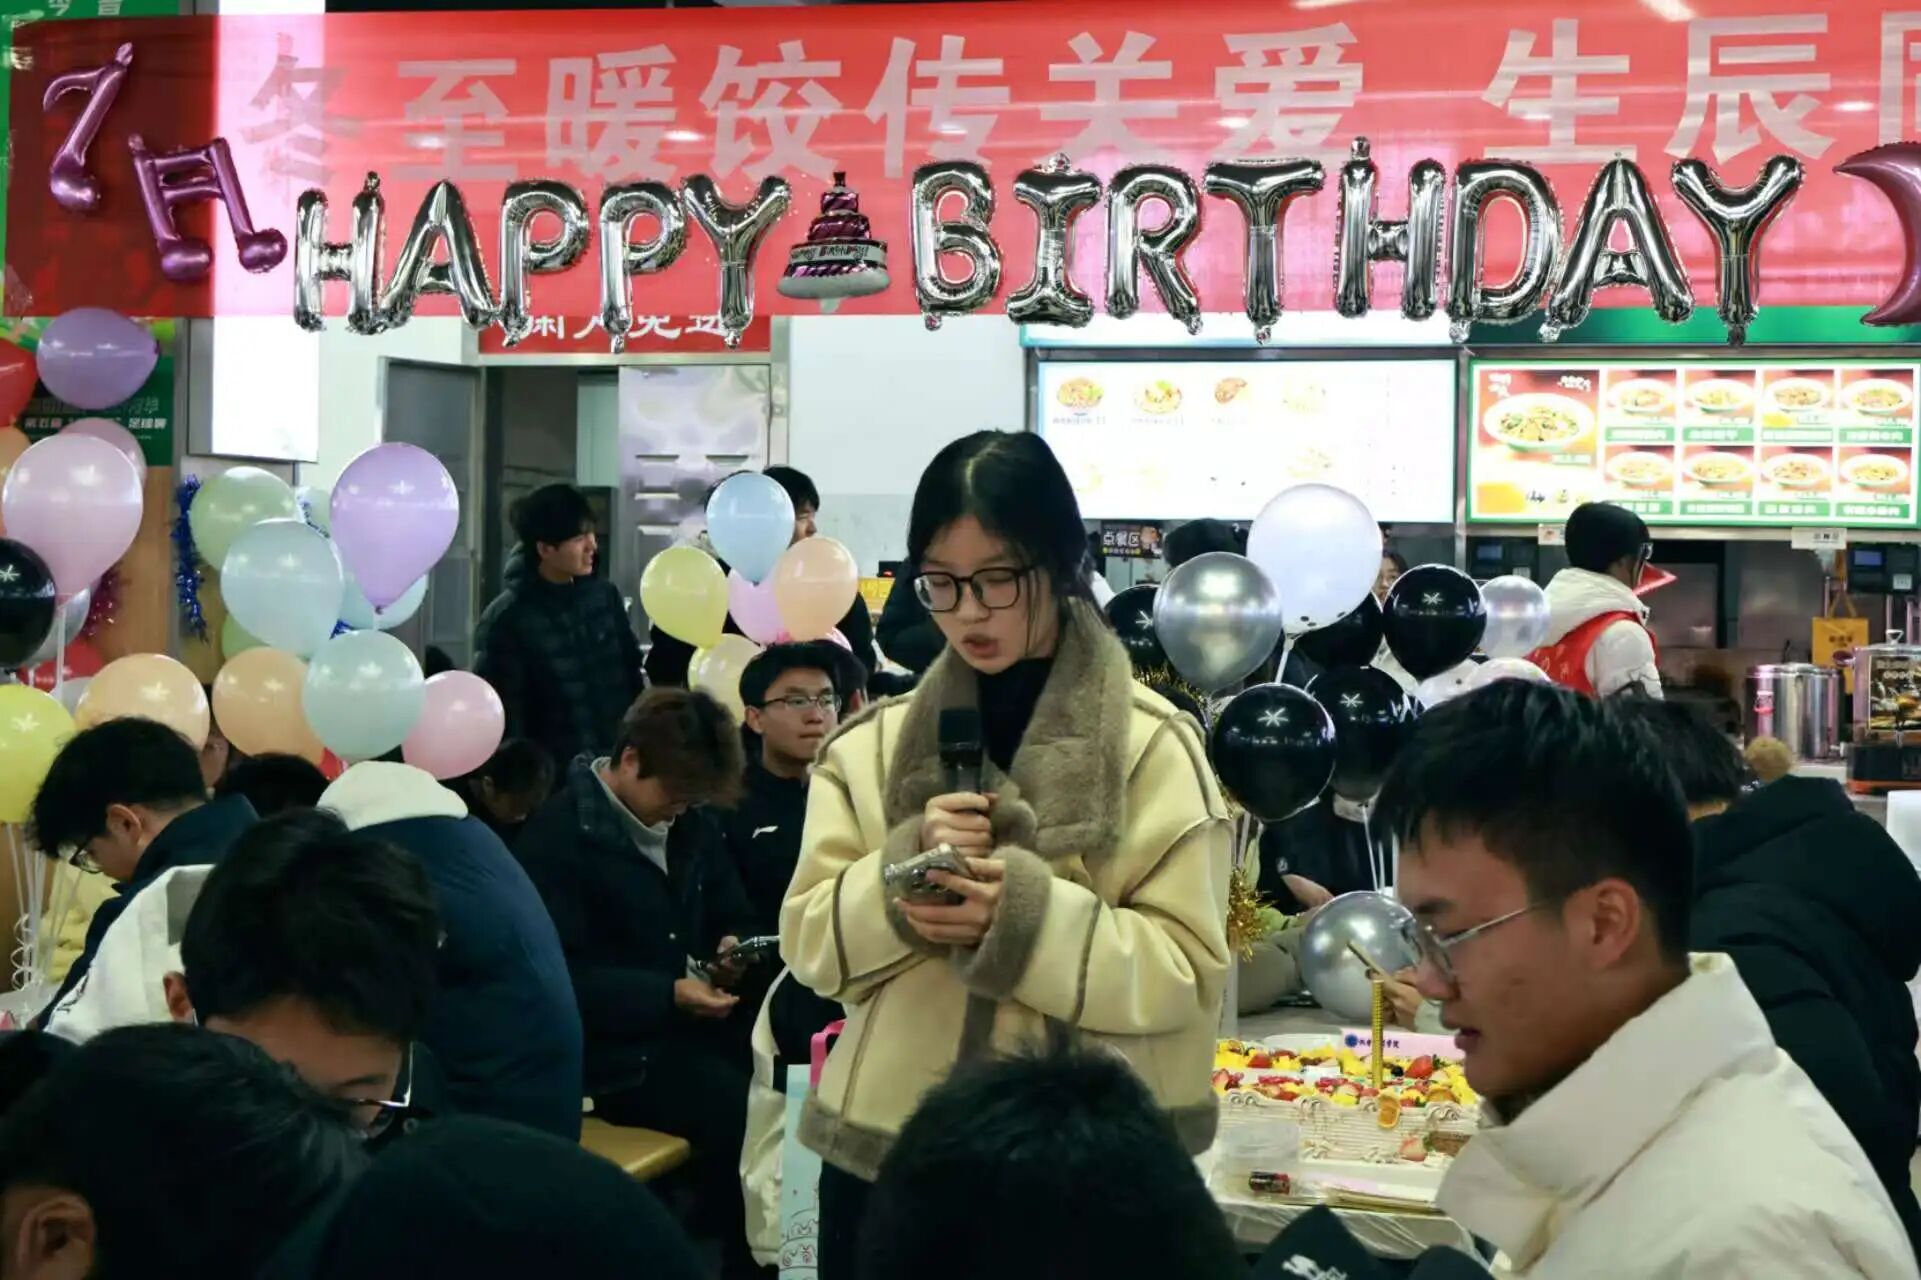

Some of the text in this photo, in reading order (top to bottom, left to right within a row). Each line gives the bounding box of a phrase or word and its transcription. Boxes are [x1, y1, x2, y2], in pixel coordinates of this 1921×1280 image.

[240, 22, 1364, 183] 冬至暖饺传关爱
[294, 138, 1806, 346] HAPPY BIRTHDAY
[1103, 530, 1140, 547] 点餐区
